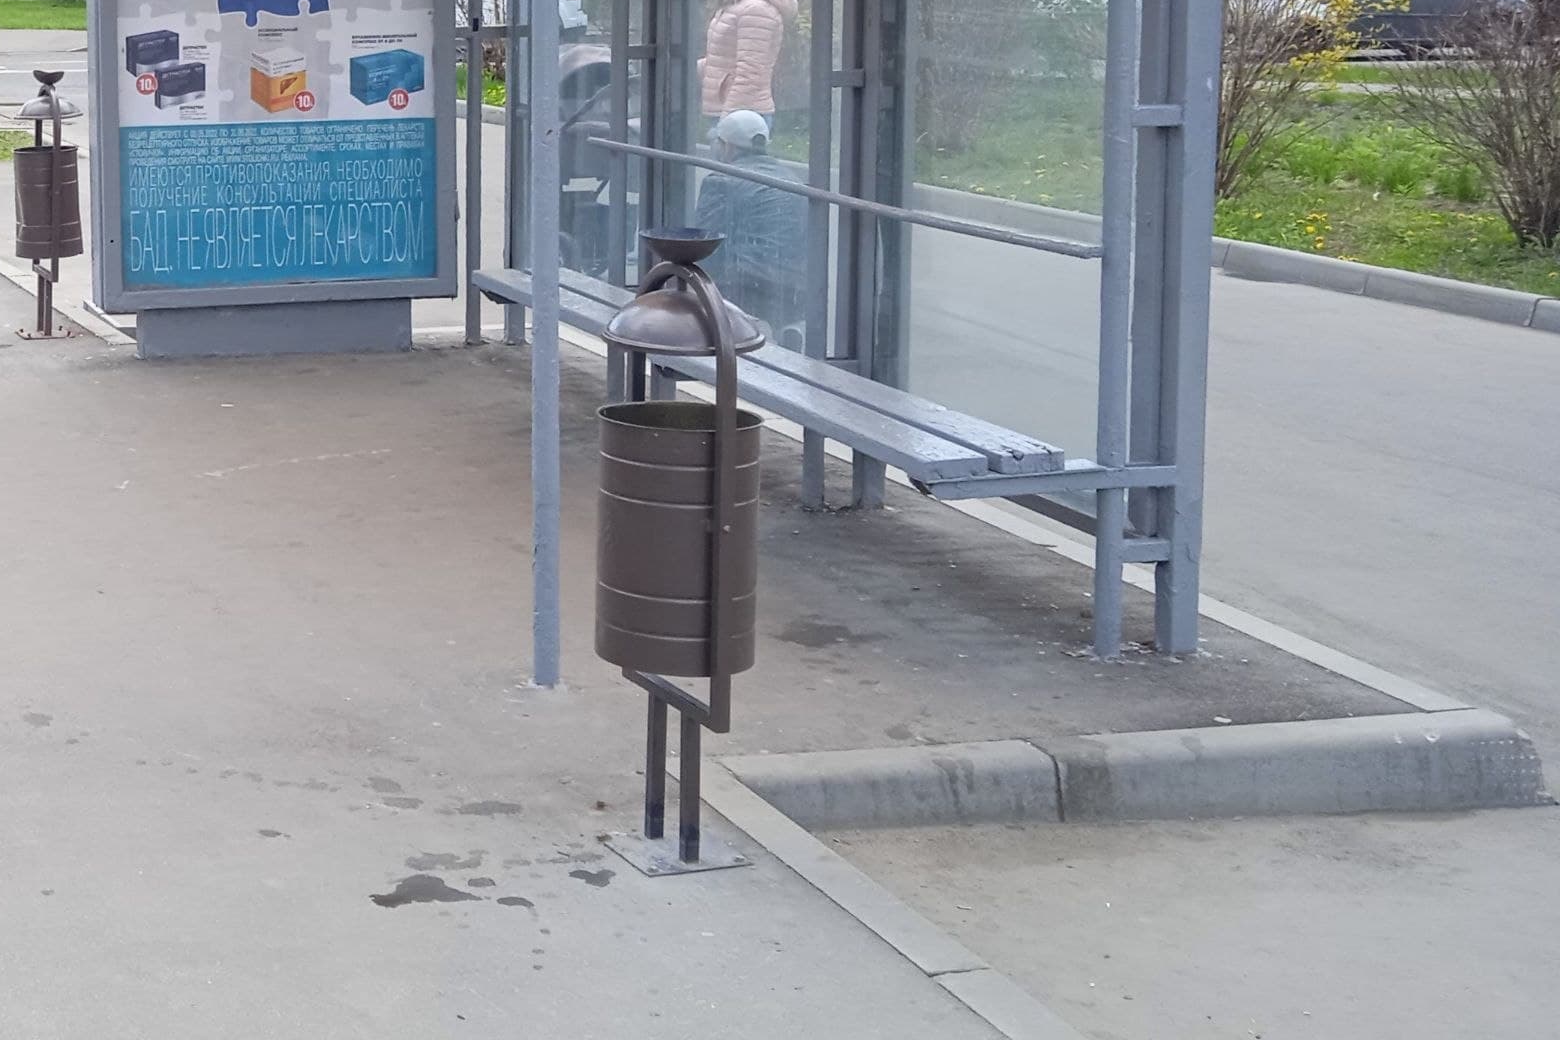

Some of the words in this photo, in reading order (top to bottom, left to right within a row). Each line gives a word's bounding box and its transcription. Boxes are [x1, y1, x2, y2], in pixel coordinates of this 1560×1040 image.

[128, 165, 192, 187] ИМЕЮТСЯ
[337, 158, 423, 180] НЕОБХОДИМО
[129, 186, 209, 208] ПОЛУЧЕНИЕ
[216, 181, 321, 204] КОНСУЛЬТАЦИИ
[329, 178, 424, 202] СПЕЦИАЛИСТА
[177, 208, 201, 270] НЕ
[203, 205, 298, 269] ЯВЛЯЕТСЯ
[300, 200, 425, 266] ЛЕКАРСТВОМ
